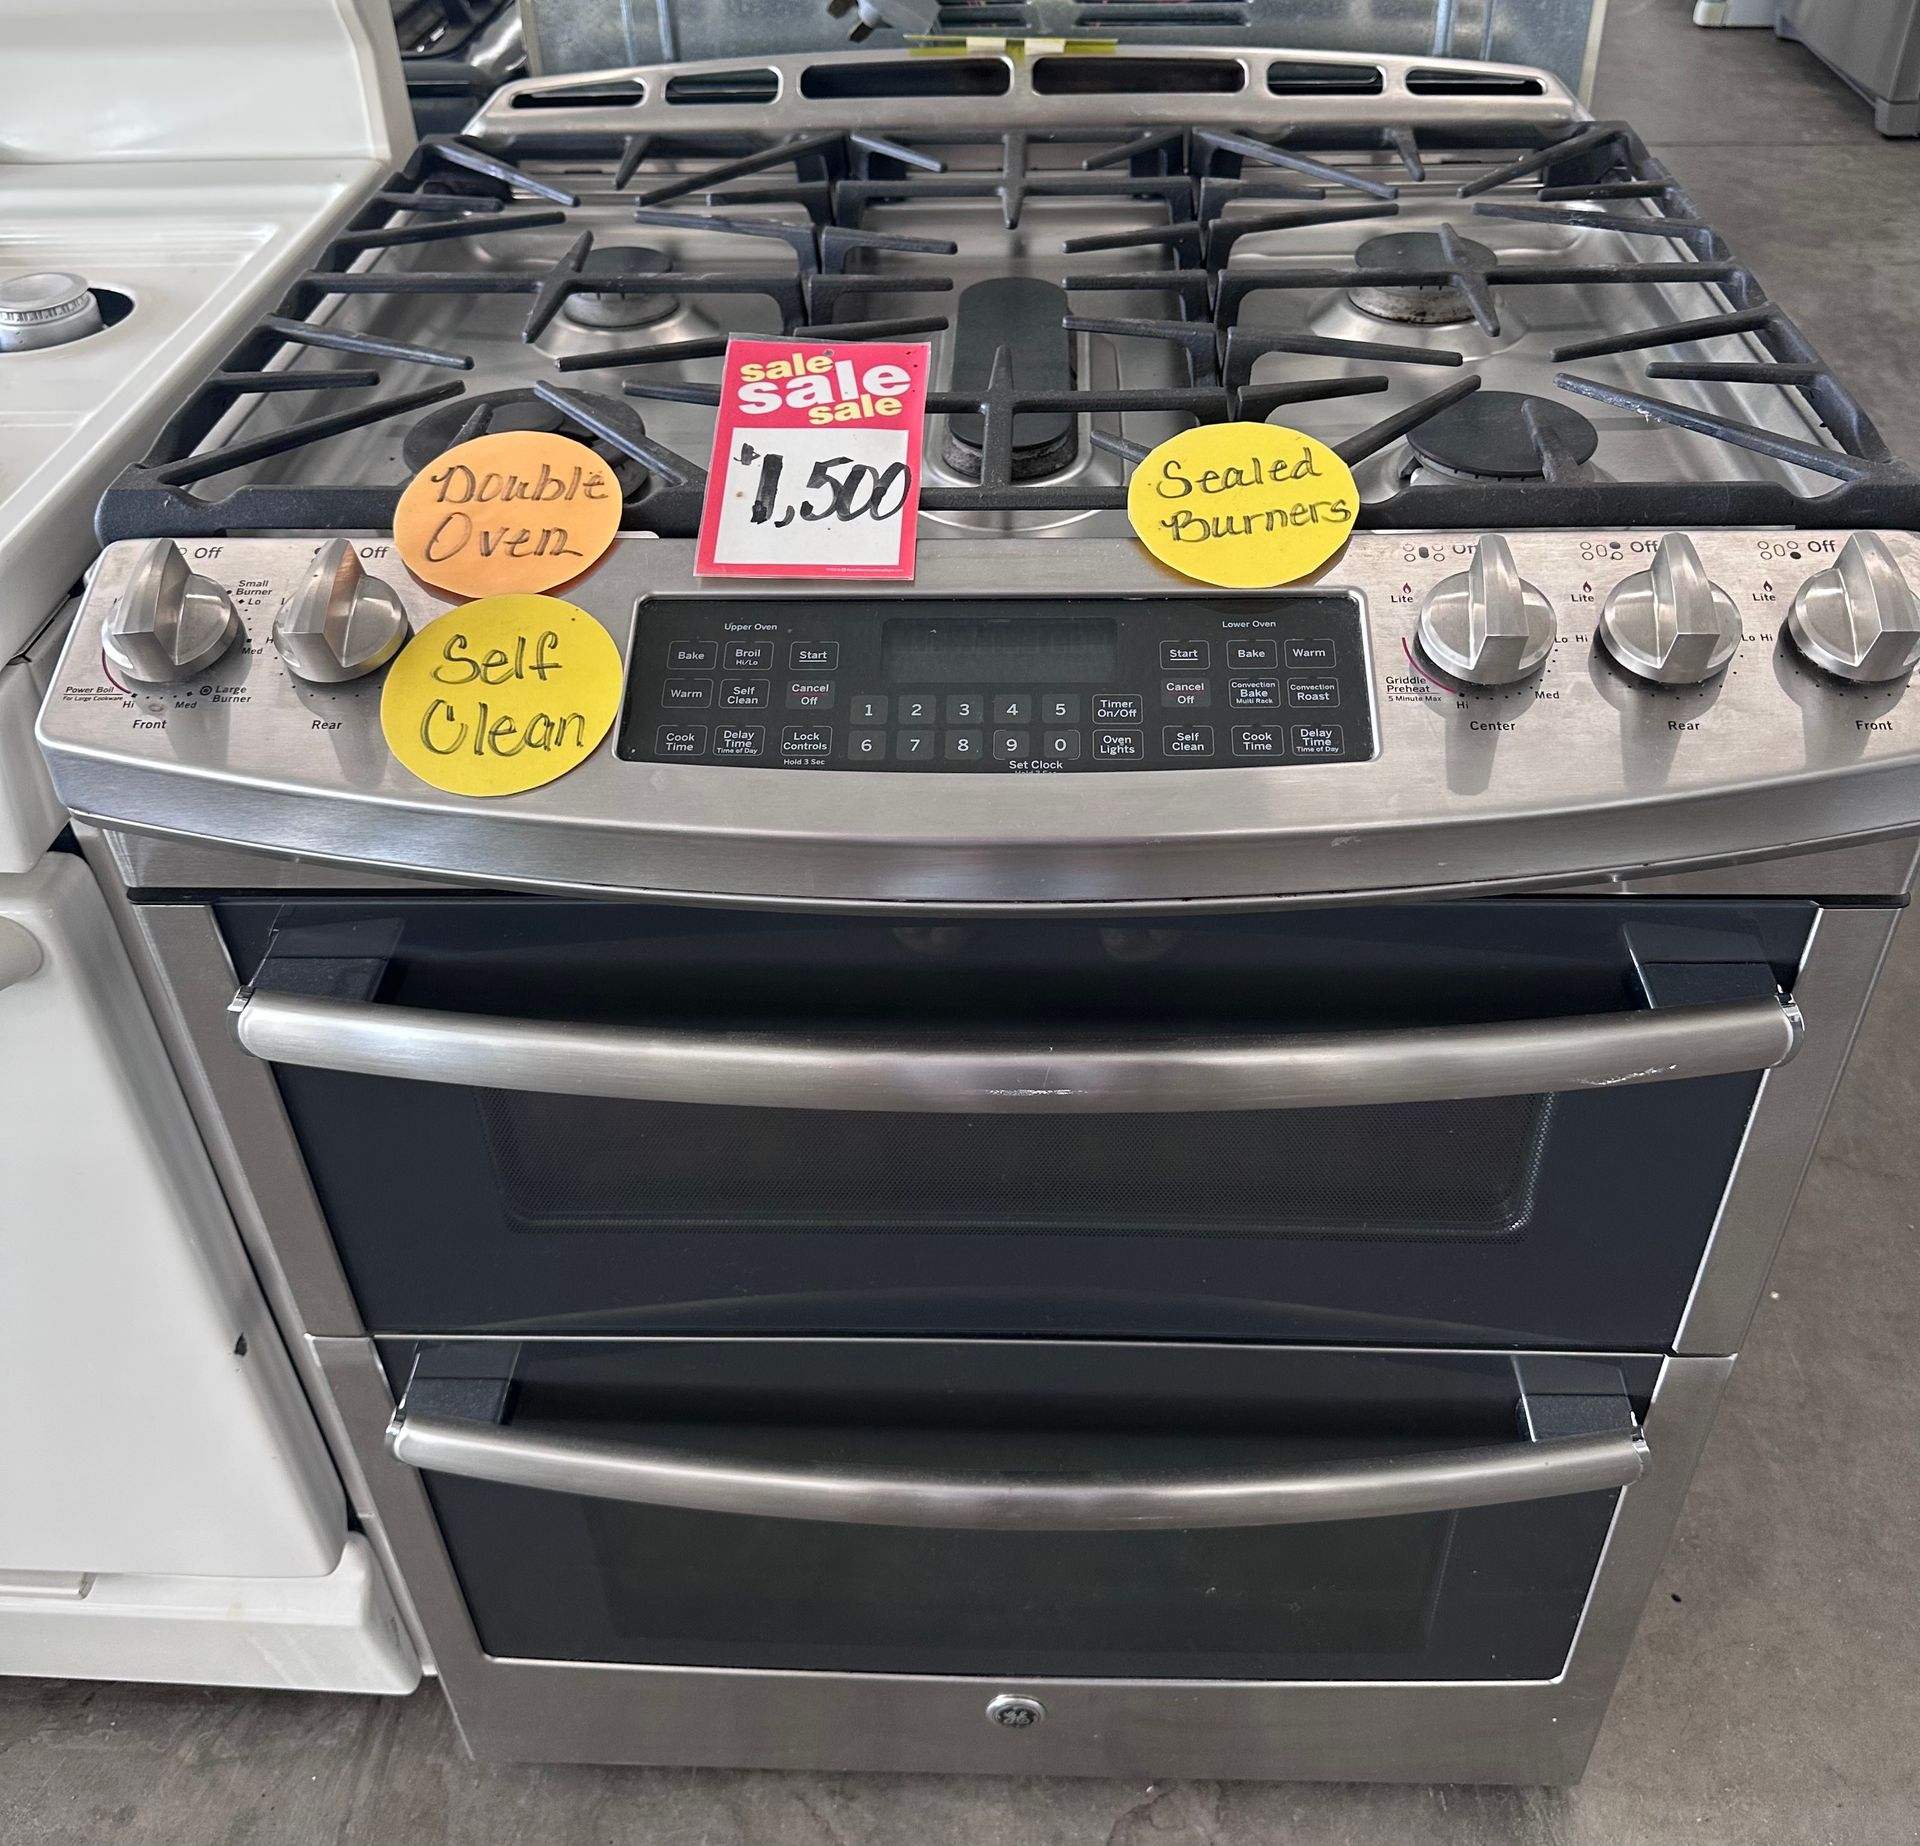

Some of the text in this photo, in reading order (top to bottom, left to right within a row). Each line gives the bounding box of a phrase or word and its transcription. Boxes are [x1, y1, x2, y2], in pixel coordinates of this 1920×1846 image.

[740, 352, 833, 382] sale
[738, 360, 912, 414] sale
[808, 394, 902, 424] sale
[1156, 447, 1322, 498] Sealed
[431, 464, 609, 503] Double
[734, 442, 912, 528] $1,500
[1160, 499, 1351, 542] Burners
[425, 512, 583, 562] Oven
[1453, 545, 1478, 554] Of
[1630, 540, 1658, 552] Off
[1808, 540, 1836, 552] Off
[194, 547, 223, 559] Off
[360, 547, 388, 559] Off
[1390, 594, 1414, 603] Lite
[1571, 594, 1594, 602] Lite
[1752, 593, 1776, 602] Lite
[724, 623, 778, 632] Upper Oven
[1222, 620, 1276, 628] Lower Oven
[1760, 634, 1773, 642] Hi
[432, 630, 562, 684] Self
[678, 651, 705, 660] Bake
[735, 648, 761, 658] Broil
[800, 650, 828, 660] Start
[1170, 648, 1198, 658] Start
[1238, 649, 1265, 658] Bake
[1292, 648, 1326, 658] Warm
[1386, 676, 1426, 685] Griddle
[216, 685, 247, 694] Large
[734, 686, 755, 696] Self
[792, 683, 830, 693] Cancel
[1166, 682, 1205, 692] Cancel
[212, 694, 251, 702] Burner
[670, 689, 702, 698] Warm
[1240, 688, 1268, 698] Bake
[1296, 692, 1330, 701] Roast
[1534, 691, 1560, 699] Med
[122, 700, 135, 708] Hi
[727, 695, 759, 705] Clean
[800, 696, 818, 706] Off
[1100, 699, 1133, 708] Timer
[1177, 695, 1194, 704] Off
[864, 704, 873, 716] 1
[911, 704, 922, 716] 2
[959, 704, 970, 716] 3
[1006, 704, 1018, 716] 4
[1056, 704, 1066, 716] 5
[1456, 701, 1469, 709] Hi
[1098, 708, 1137, 718] On/Off
[132, 720, 167, 728] Front
[312, 720, 342, 730] Rear
[420, 699, 585, 756] Clean
[1470, 721, 1516, 731] Center
[1668, 720, 1700, 730] Rear
[1856, 720, 1893, 730] Front
[666, 732, 695, 742] Cook
[723, 730, 755, 741] Delay
[794, 732, 820, 741] Lock
[1176, 732, 1199, 742] Self
[1242, 732, 1272, 742] Cook
[1300, 728, 1332, 740] Delay
[724, 738, 752, 748] Time
[1102, 735, 1132, 744] Oven
[1302, 736, 1332, 746] Time
[666, 742, 694, 752] Time
[783, 741, 828, 751] Controls
[861, 739, 872, 752] 6
[910, 739, 920, 752] 7
[958, 739, 969, 752] 8
[1006, 739, 1018, 752] 9
[1054, 739, 1066, 752] 0
[1100, 744, 1136, 756] Lights
[1172, 742, 1205, 752] Clean
[1242, 741, 1272, 751] Time
[1009, 760, 1064, 769] Set Clock
